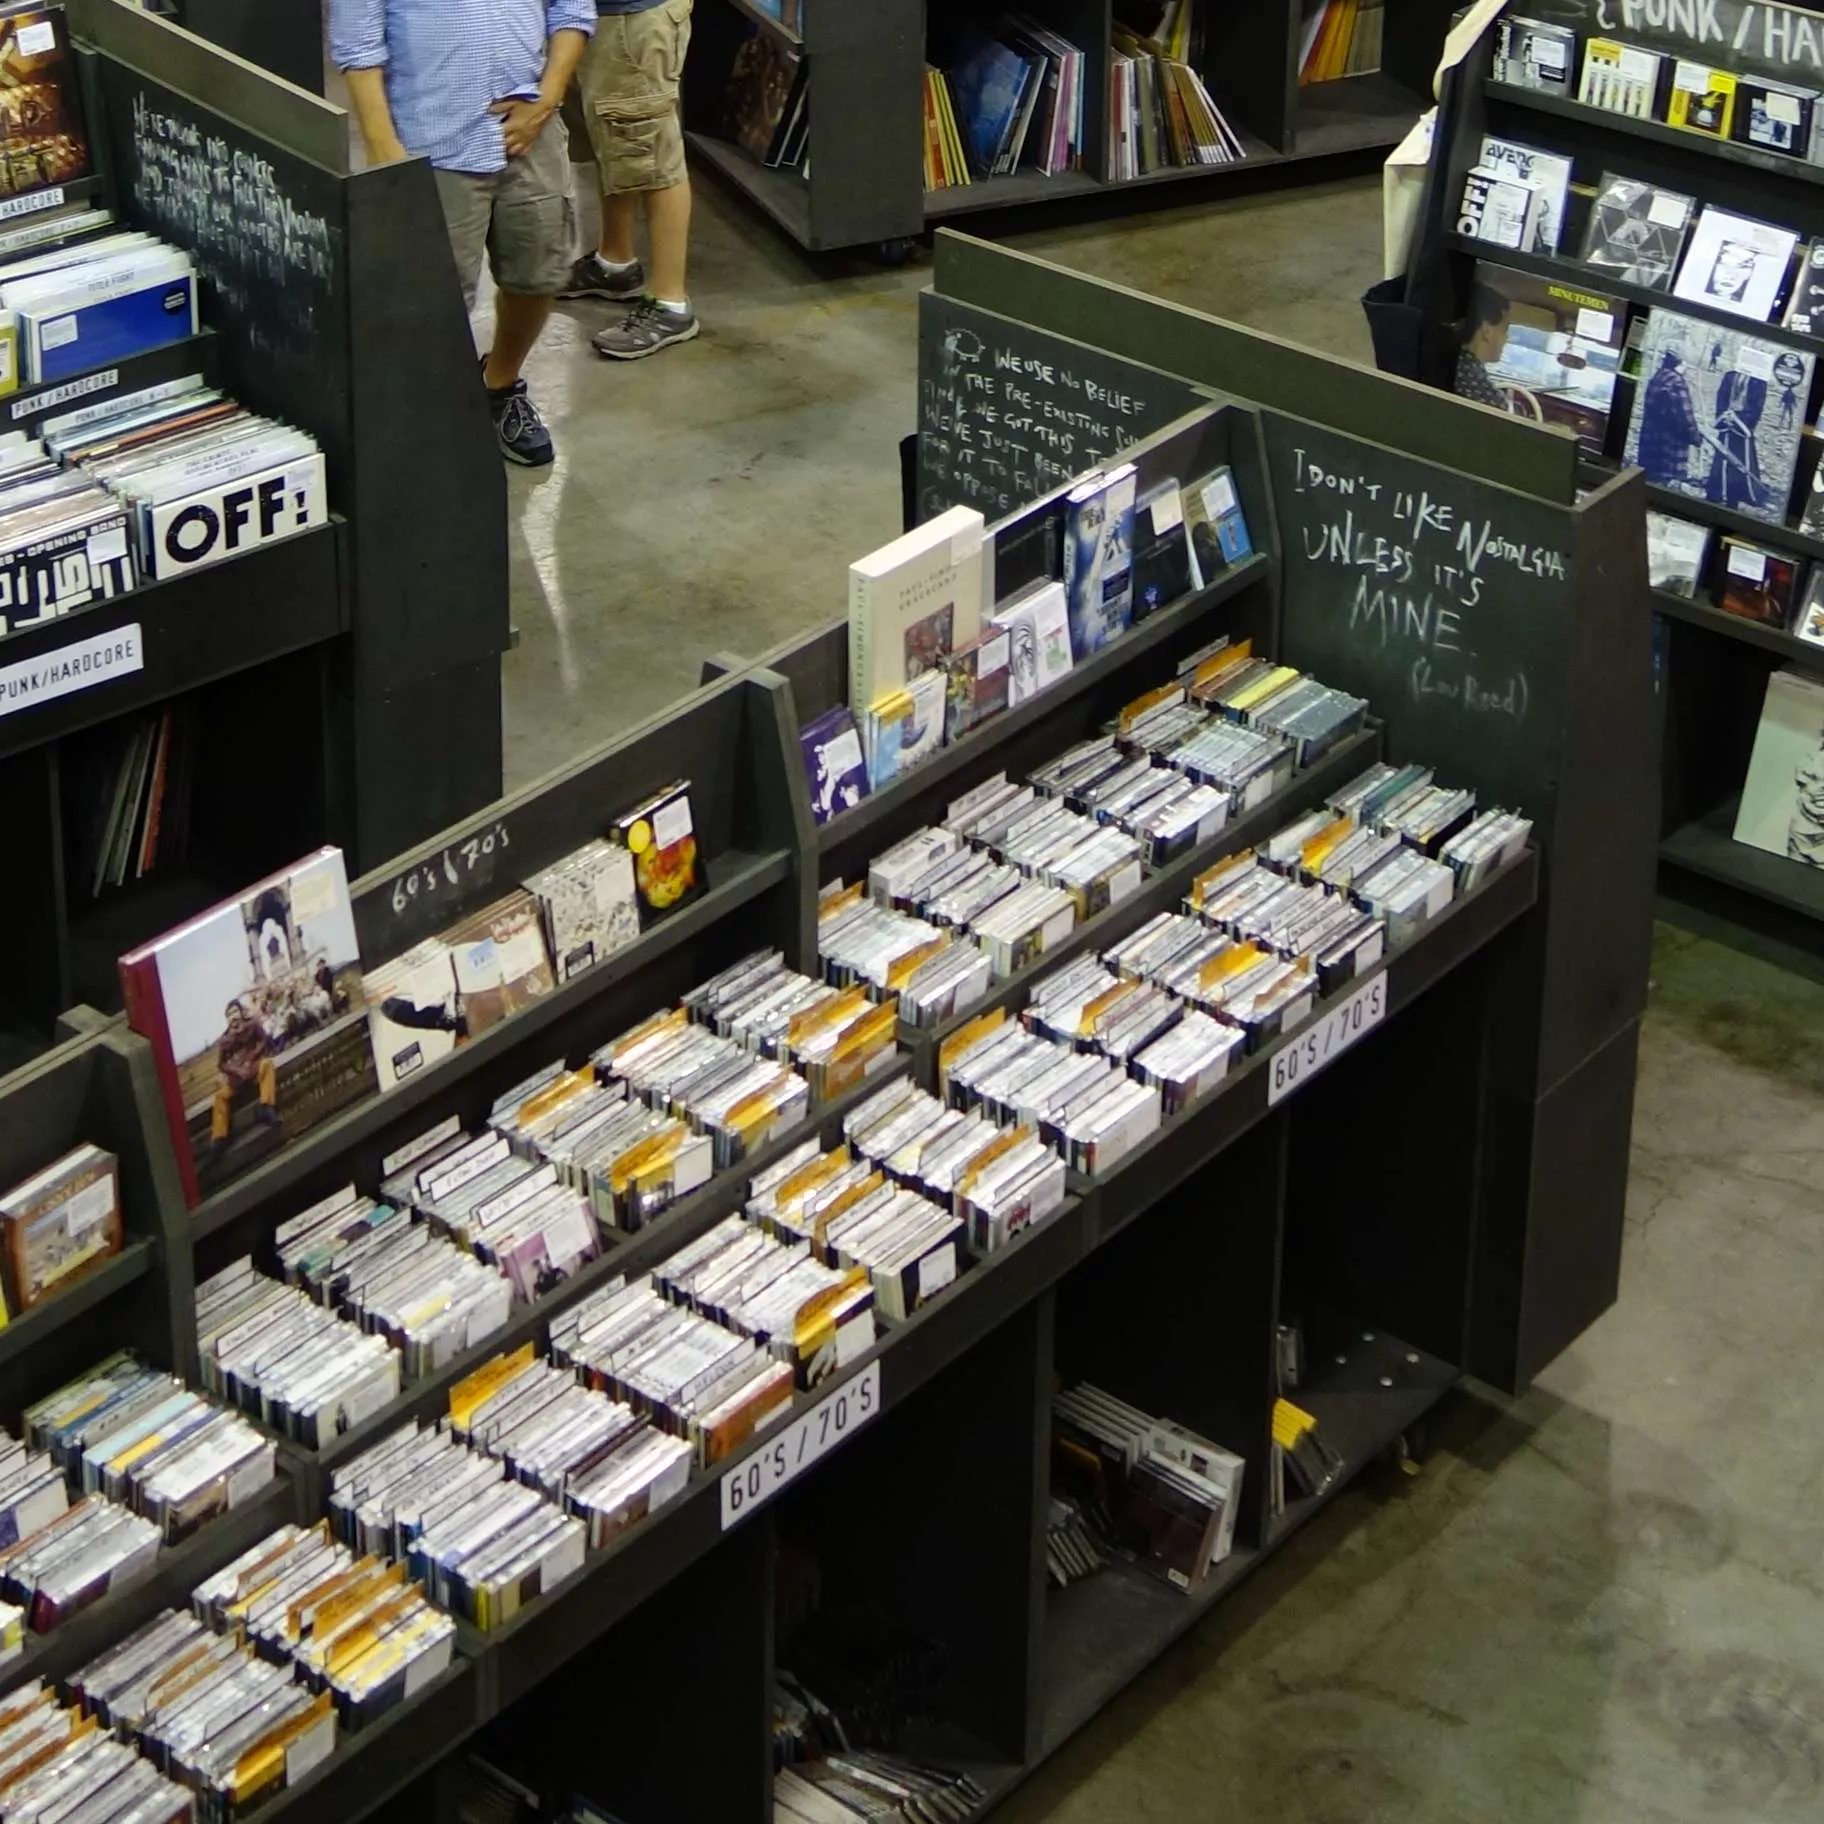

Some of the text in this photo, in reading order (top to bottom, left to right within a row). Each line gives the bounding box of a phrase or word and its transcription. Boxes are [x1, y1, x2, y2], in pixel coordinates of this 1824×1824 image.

[1, 191, 62, 219] HARDCORE
[1547, 284, 1609, 311] MINUTEMEN
[15, 372, 117, 417] PUNK HARDCORE
[164, 475, 311, 564] OFF!
[1392, 490, 1454, 541] LIKE
[26, 532, 87, 558] OPENING
[1301, 512, 1416, 582] UNLESS
[1273, 981, 1384, 1091] 60'S 70'S
[729, 1376, 874, 1511] 60'S 70'S
